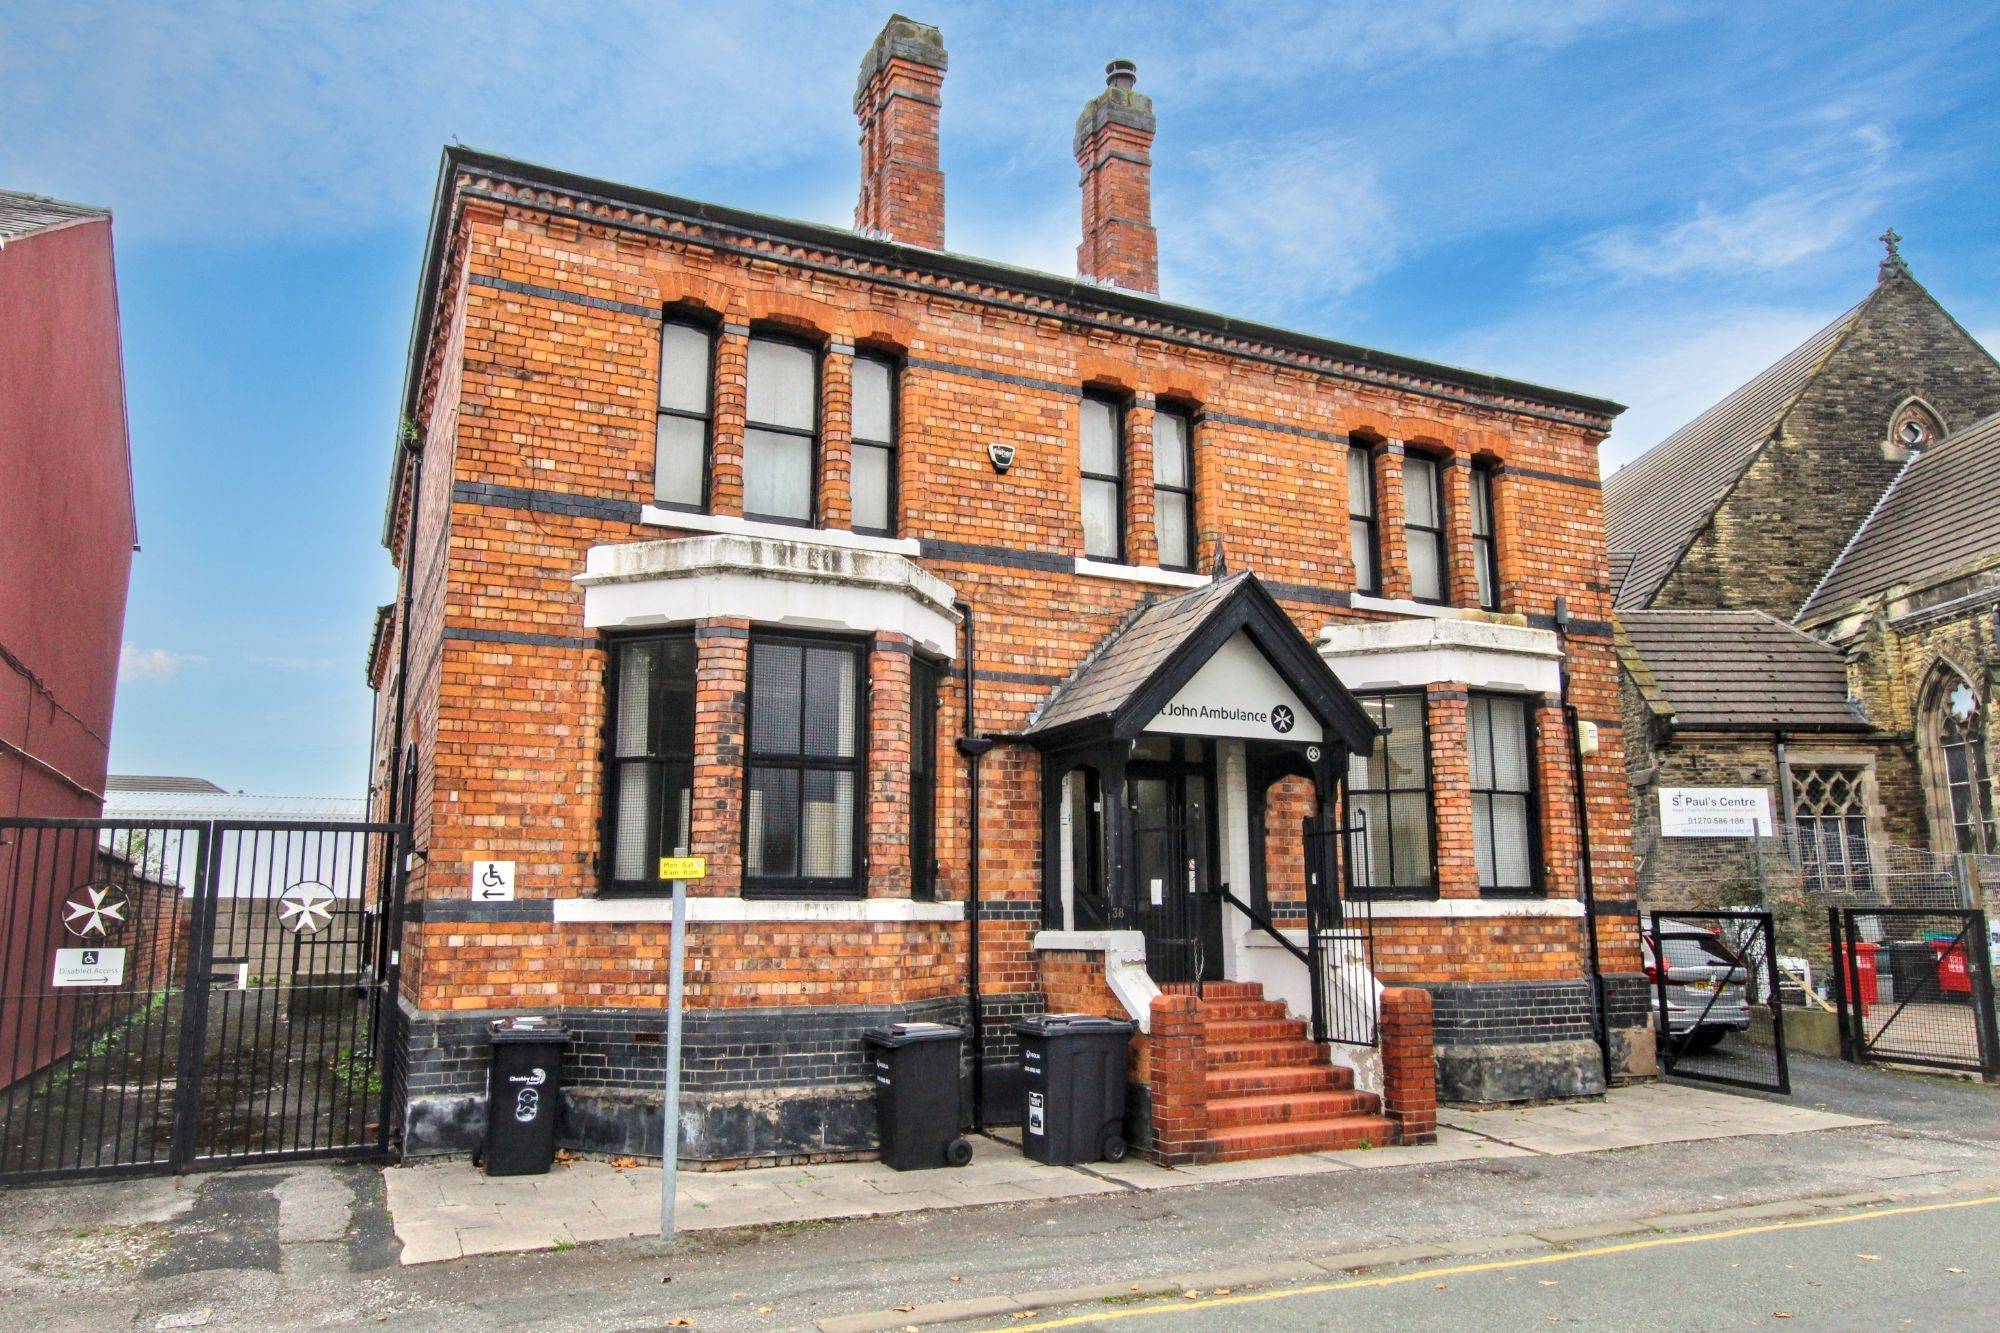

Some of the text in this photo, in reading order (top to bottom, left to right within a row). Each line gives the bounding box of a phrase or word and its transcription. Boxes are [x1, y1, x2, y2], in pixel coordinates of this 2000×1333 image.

[1168, 703, 1198, 718] John
[1200, 706, 1267, 723] Ambulance
[1685, 797, 1717, 807] Paul's
[1719, 797, 1756, 807] Centre
[1688, 817, 1712, 825] 01270
[1713, 817, 1728, 825] 586
[1112, 907, 1125, 919] 38
[59, 967, 92, 975] Disabled
